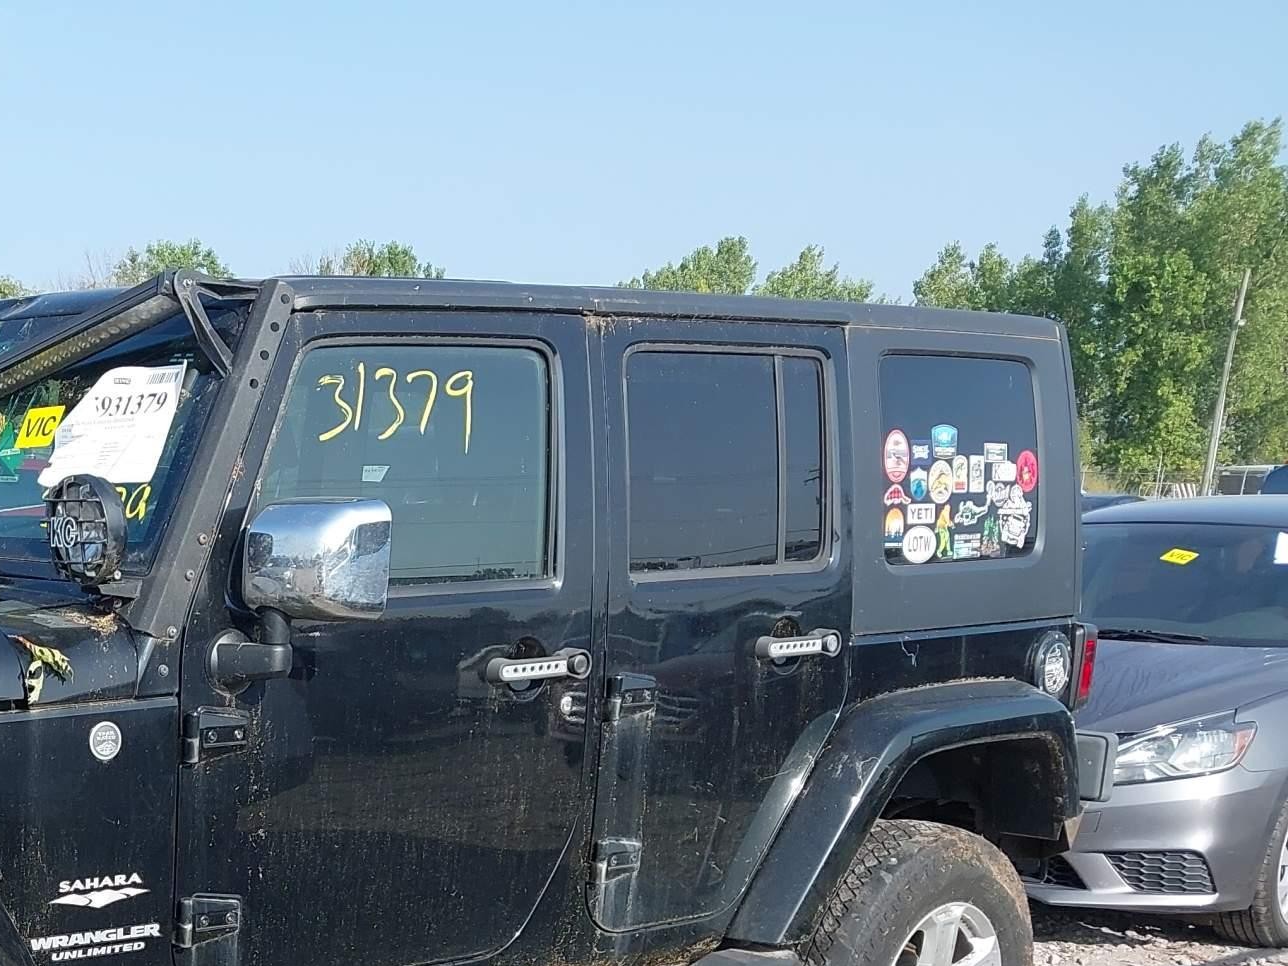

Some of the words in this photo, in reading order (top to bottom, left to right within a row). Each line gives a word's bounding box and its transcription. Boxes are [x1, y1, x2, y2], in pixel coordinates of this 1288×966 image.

[316, 362, 473, 454] 31379
[25, 415, 57, 438] VIC
[910, 507, 934, 520] YETI
[51, 517, 78, 548] KC
[907, 535, 932, 552] LOTW
[58, 872, 143, 893] SAHARA
[30, 923, 161, 951] WRANGLER
[51, 941, 146, 962] UNLIMITED
